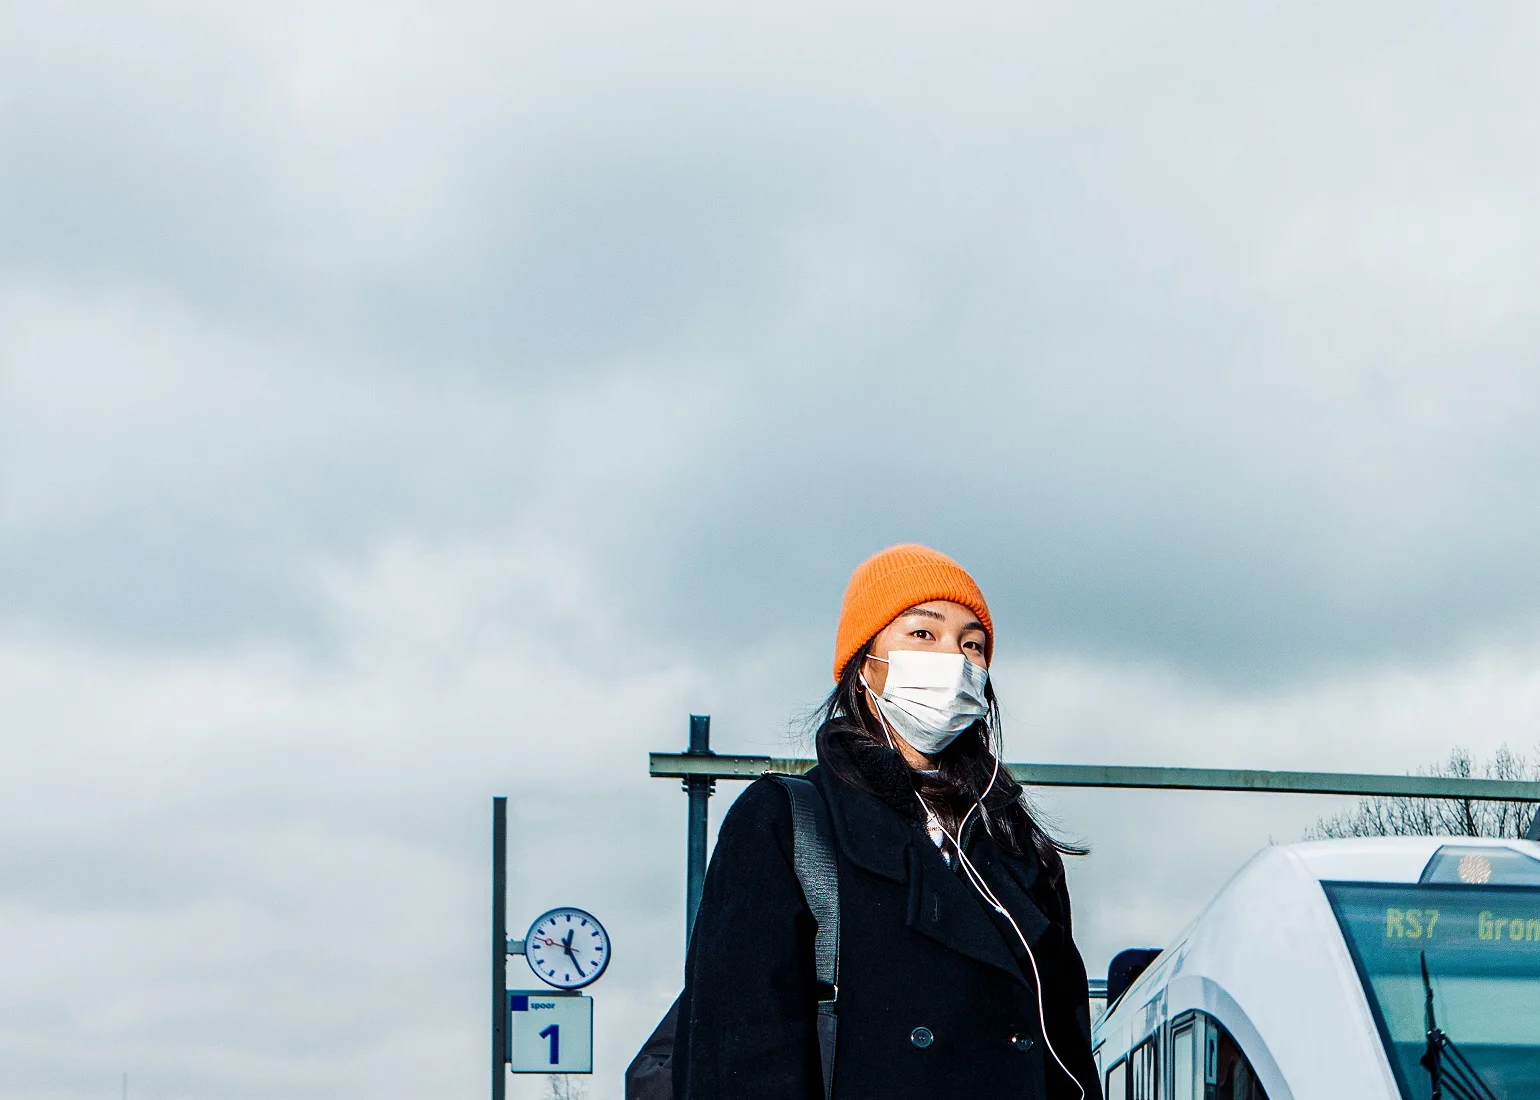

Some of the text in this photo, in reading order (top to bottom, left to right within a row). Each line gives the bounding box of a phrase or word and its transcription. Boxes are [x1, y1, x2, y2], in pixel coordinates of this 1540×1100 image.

[1385, 907, 1440, 939] RS7
[530, 1001, 556, 1010] spoor
[538, 1023, 560, 1065] 1
